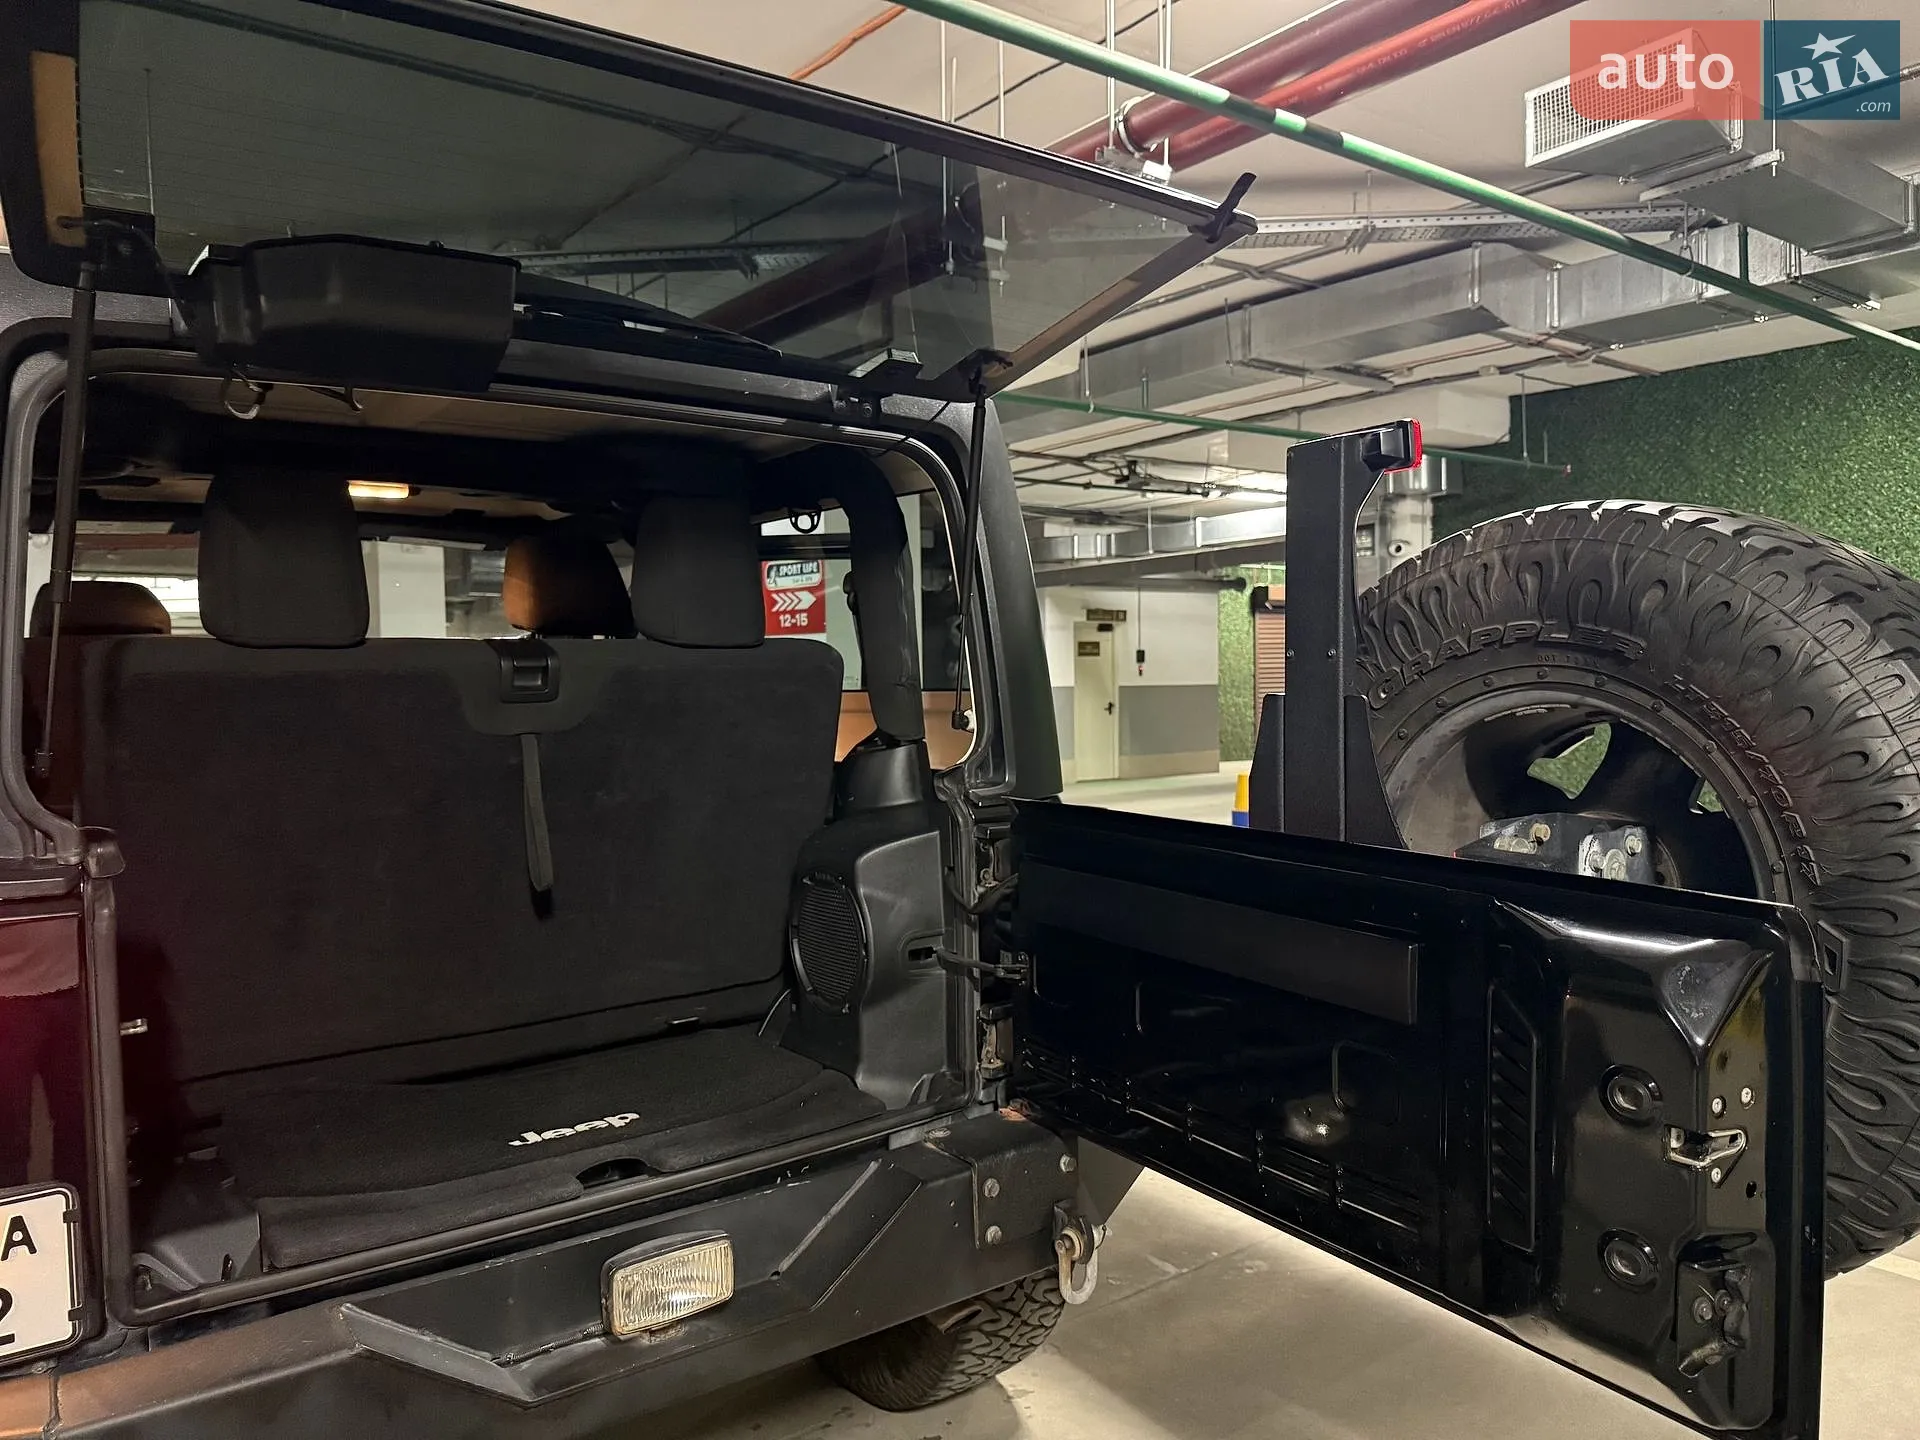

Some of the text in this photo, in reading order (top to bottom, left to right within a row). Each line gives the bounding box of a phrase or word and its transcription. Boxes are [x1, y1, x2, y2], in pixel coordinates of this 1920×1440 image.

[779, 564, 801, 576] SPORT
[1367, 620, 1648, 710] GRAPPLER
[508, 1112, 641, 1146] Jeep
[1, 1215, 38, 1262] A
